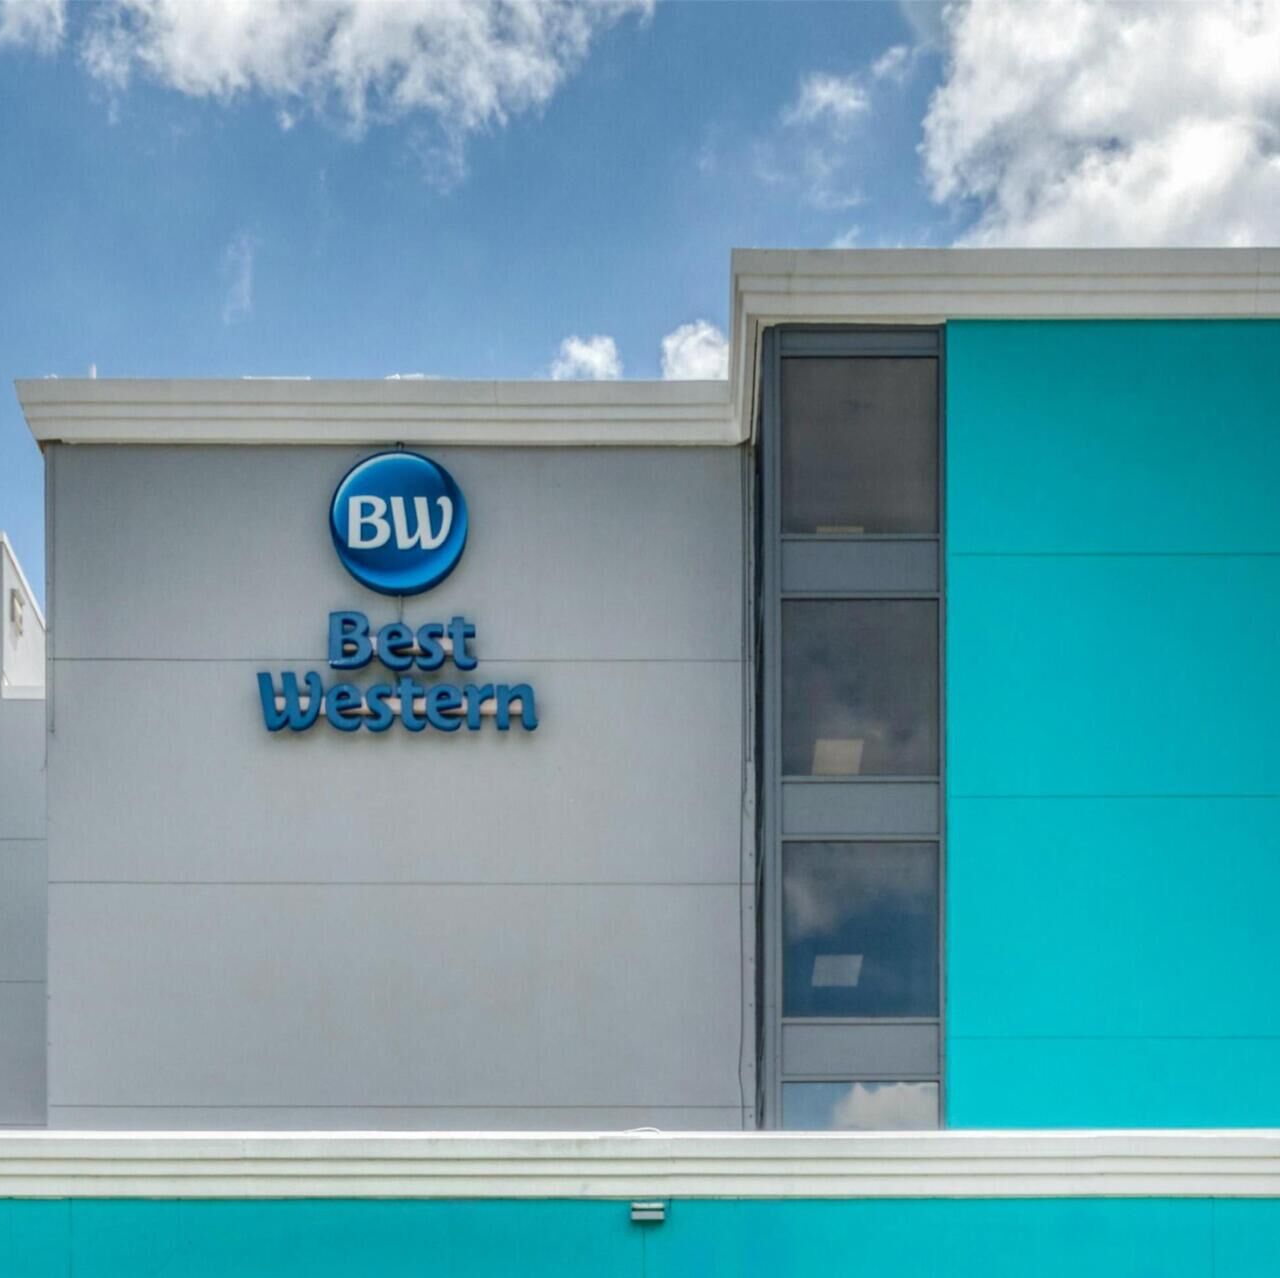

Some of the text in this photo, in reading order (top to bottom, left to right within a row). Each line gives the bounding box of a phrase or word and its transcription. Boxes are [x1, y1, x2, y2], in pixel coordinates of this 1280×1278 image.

[347, 495, 454, 550] BW
[328, 611, 478, 670] Best
[256, 671, 538, 732] Western
